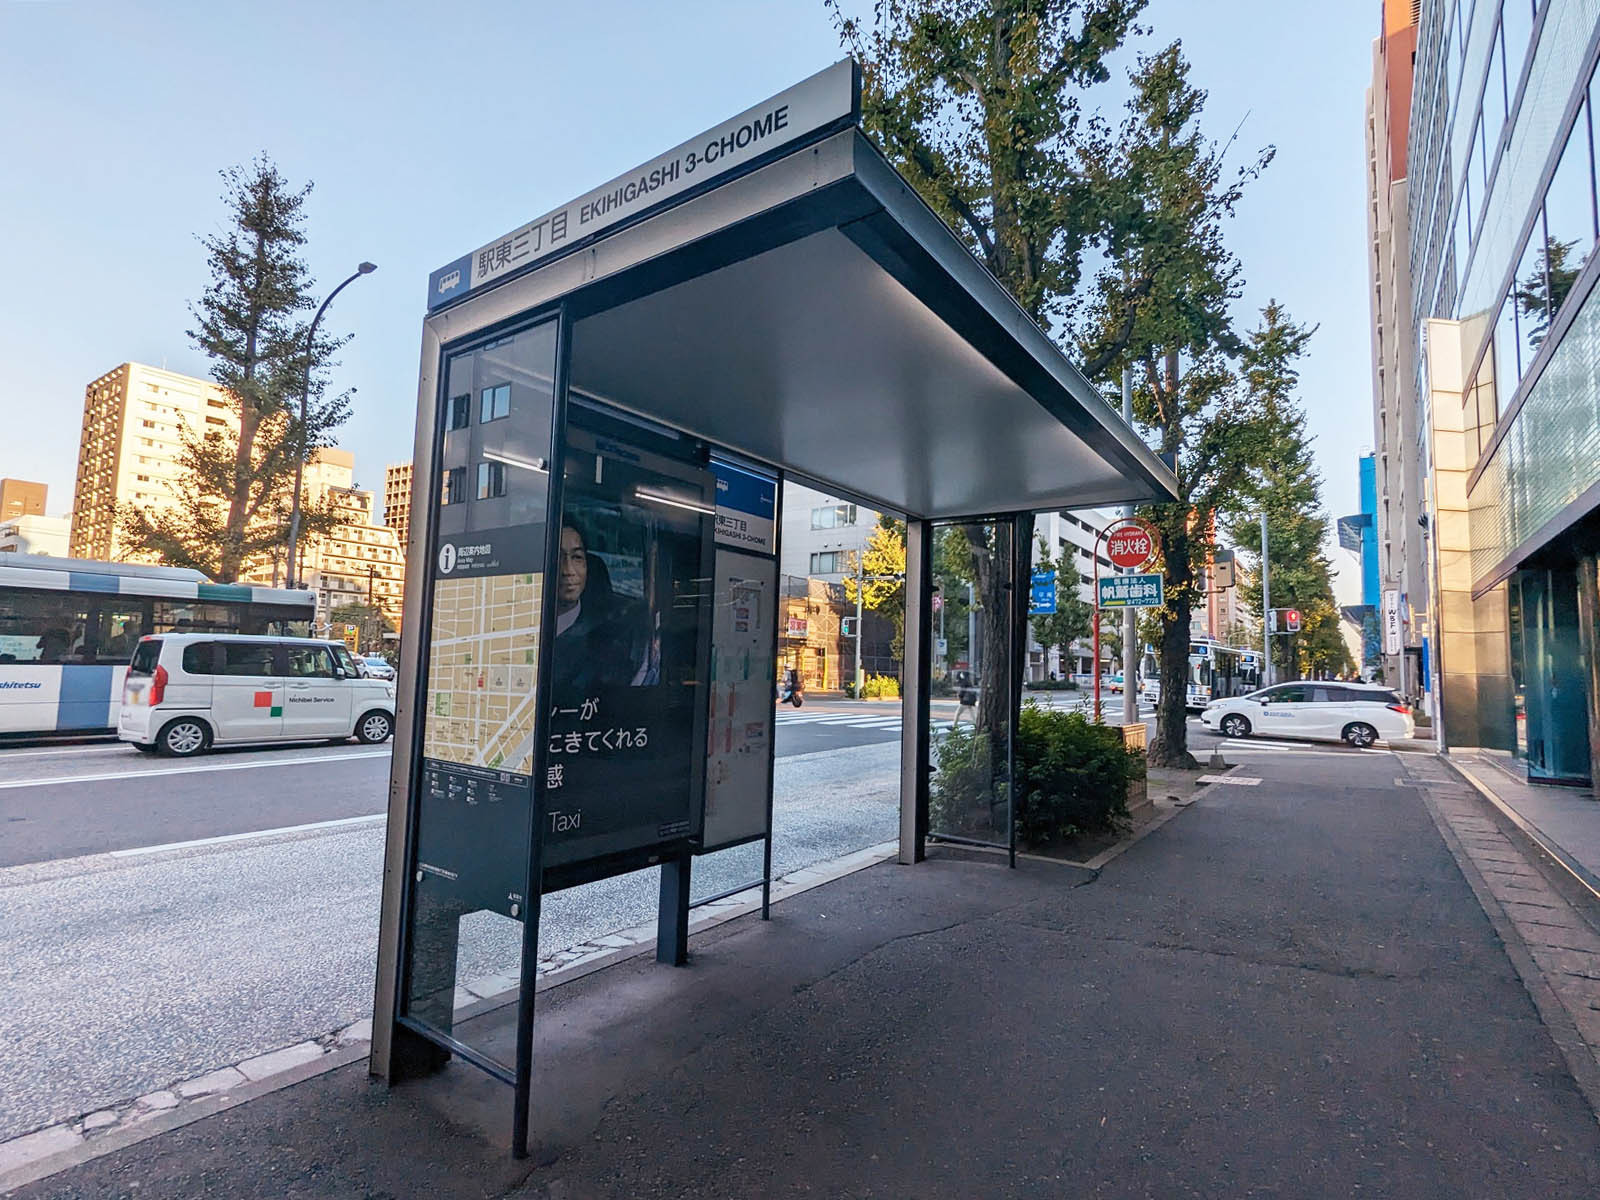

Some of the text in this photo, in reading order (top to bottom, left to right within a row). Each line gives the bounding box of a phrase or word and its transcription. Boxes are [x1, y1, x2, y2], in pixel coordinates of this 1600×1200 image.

[580, 104, 790, 225] EKIHIGASHI 3-CHOME
[477, 209, 569, 278] 駅東三丁目
[742, 534, 767, 546] 3-CHOME
[1110, 538, 1148, 556] 消火栓
[548, 808, 582, 832] Taxi
